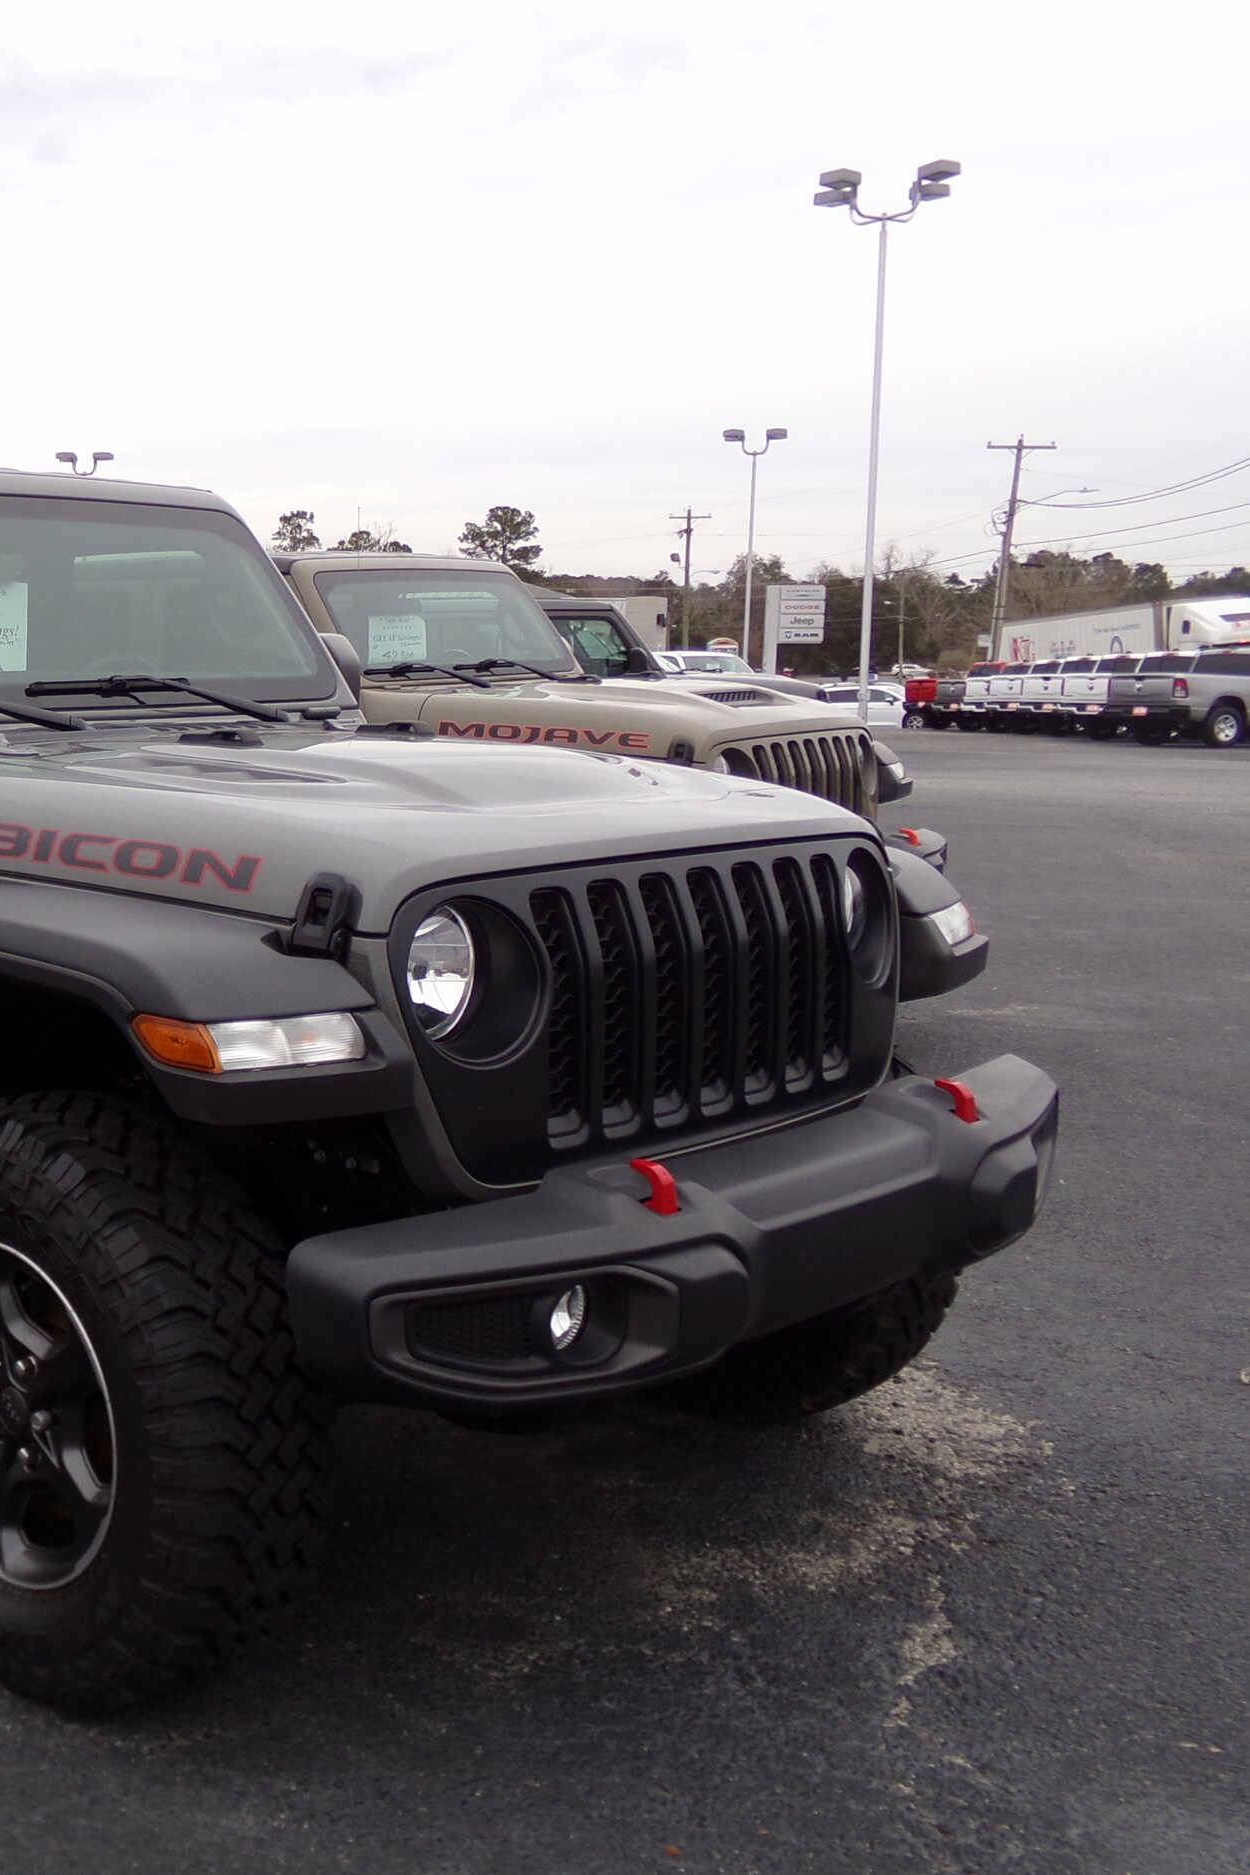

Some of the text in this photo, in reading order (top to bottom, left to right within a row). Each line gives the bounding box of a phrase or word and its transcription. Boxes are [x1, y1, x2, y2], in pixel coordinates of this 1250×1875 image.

[790, 616, 815, 626] Jeep
[372, 634, 397, 642] GREAT
[436, 720, 650, 750] MOJAVE
